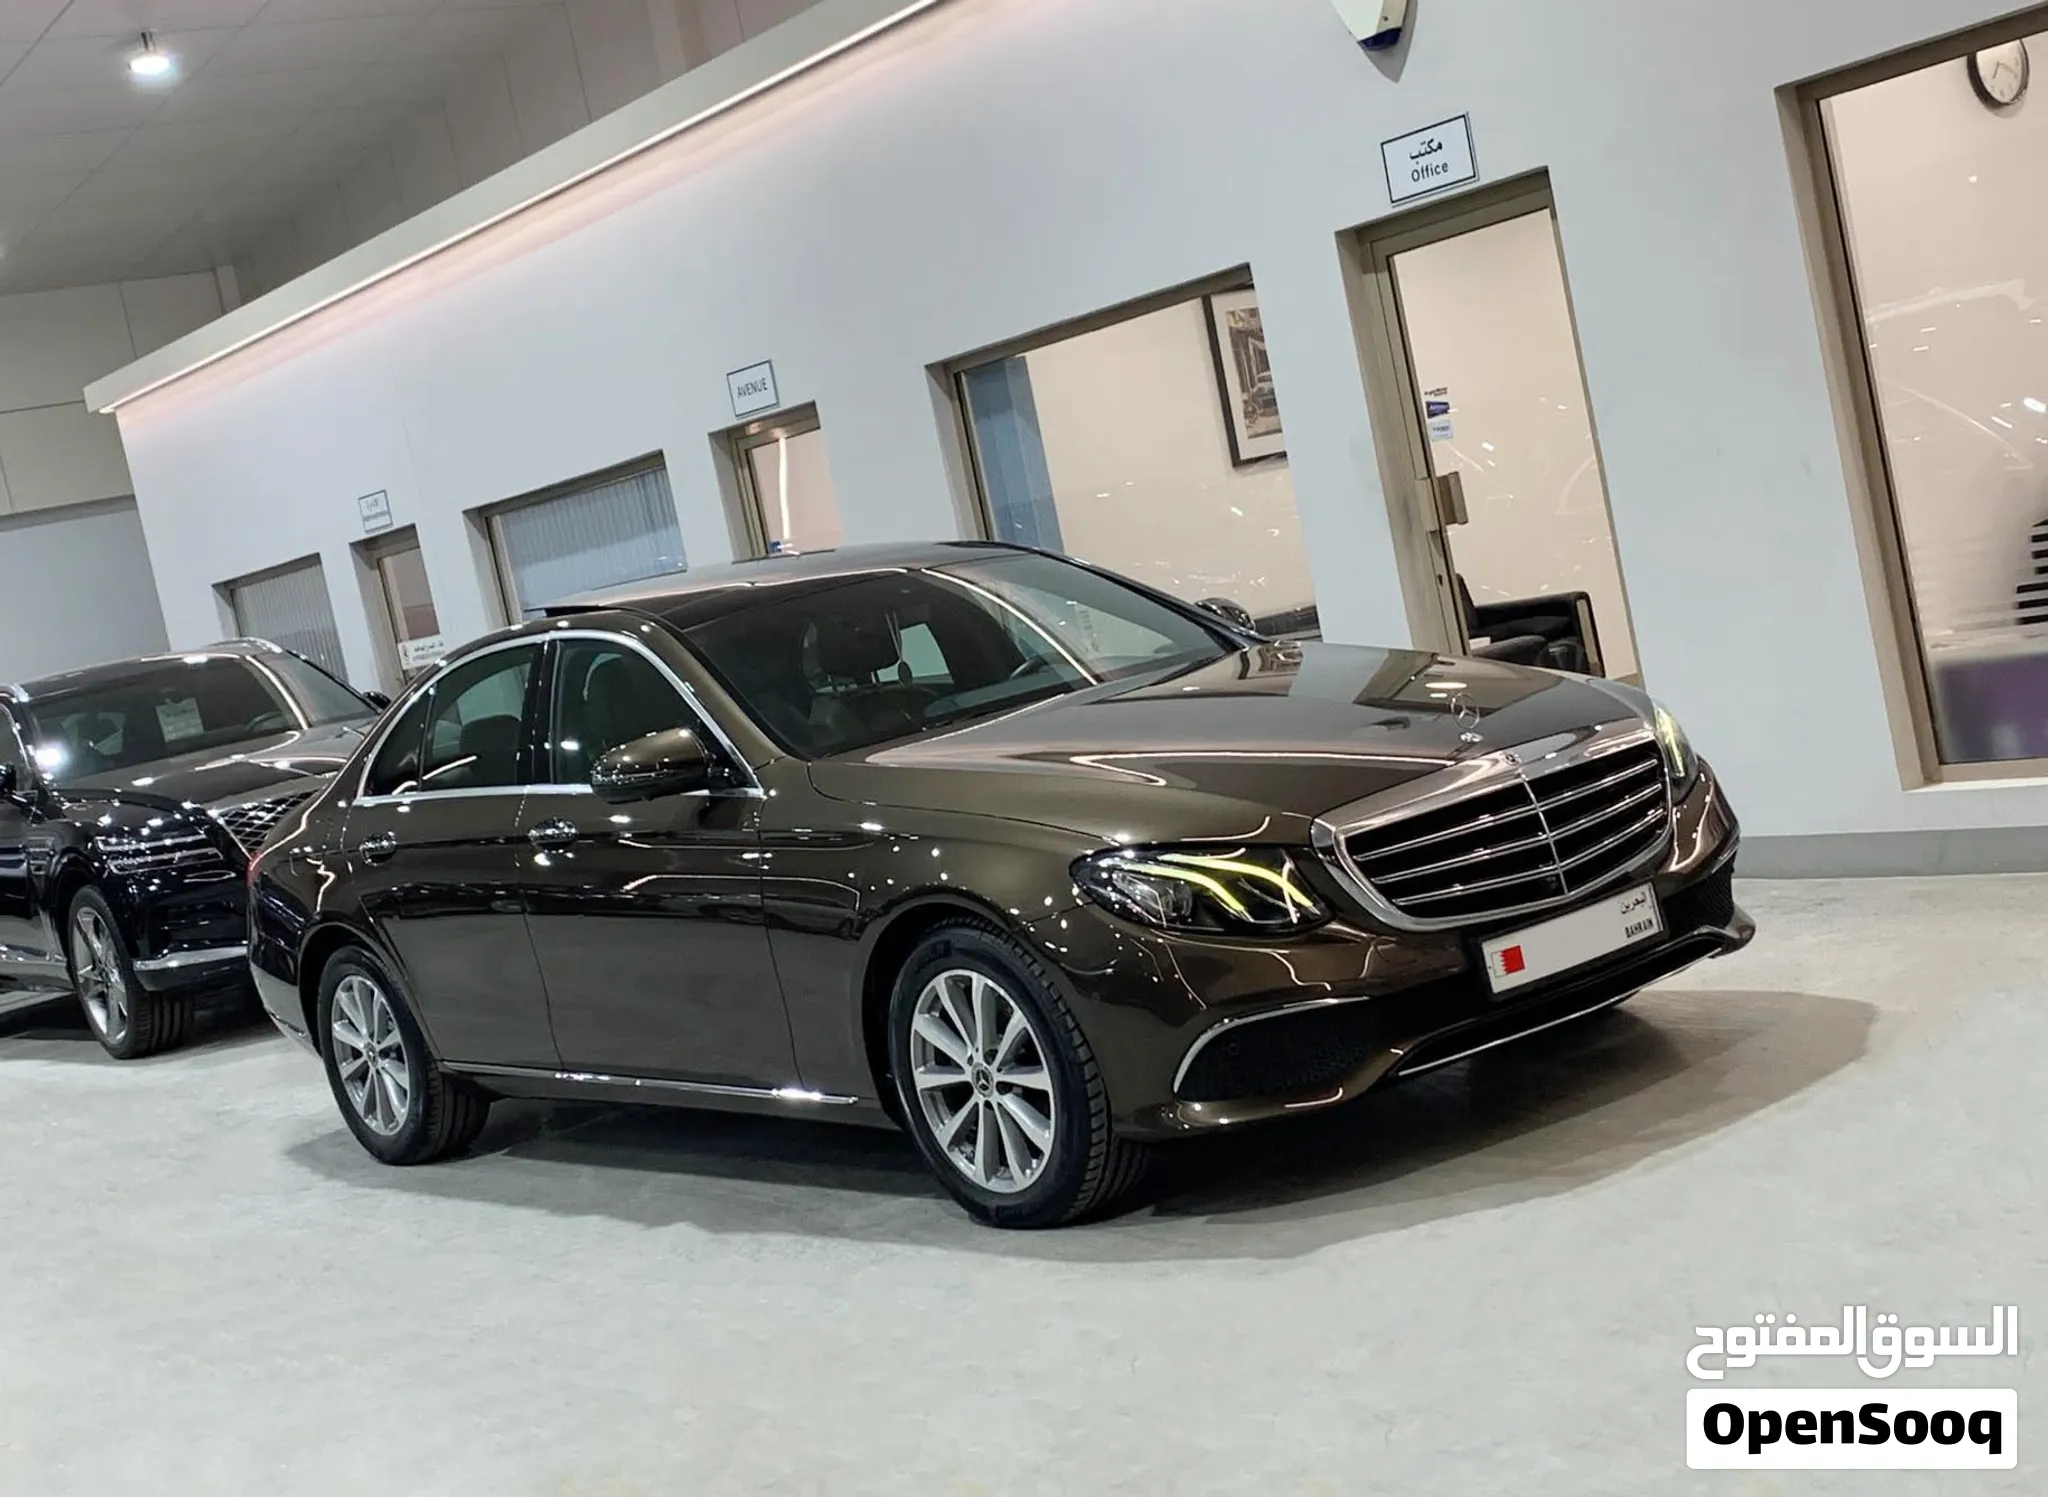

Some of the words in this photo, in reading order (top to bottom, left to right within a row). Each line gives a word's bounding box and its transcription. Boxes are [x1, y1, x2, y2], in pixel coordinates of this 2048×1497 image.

[1409, 138, 1443, 165] مكتب
[1411, 162, 1448, 182] Office
[737, 377, 768, 397] AVENUE
[1624, 918, 1654, 938] BAHRAIN
